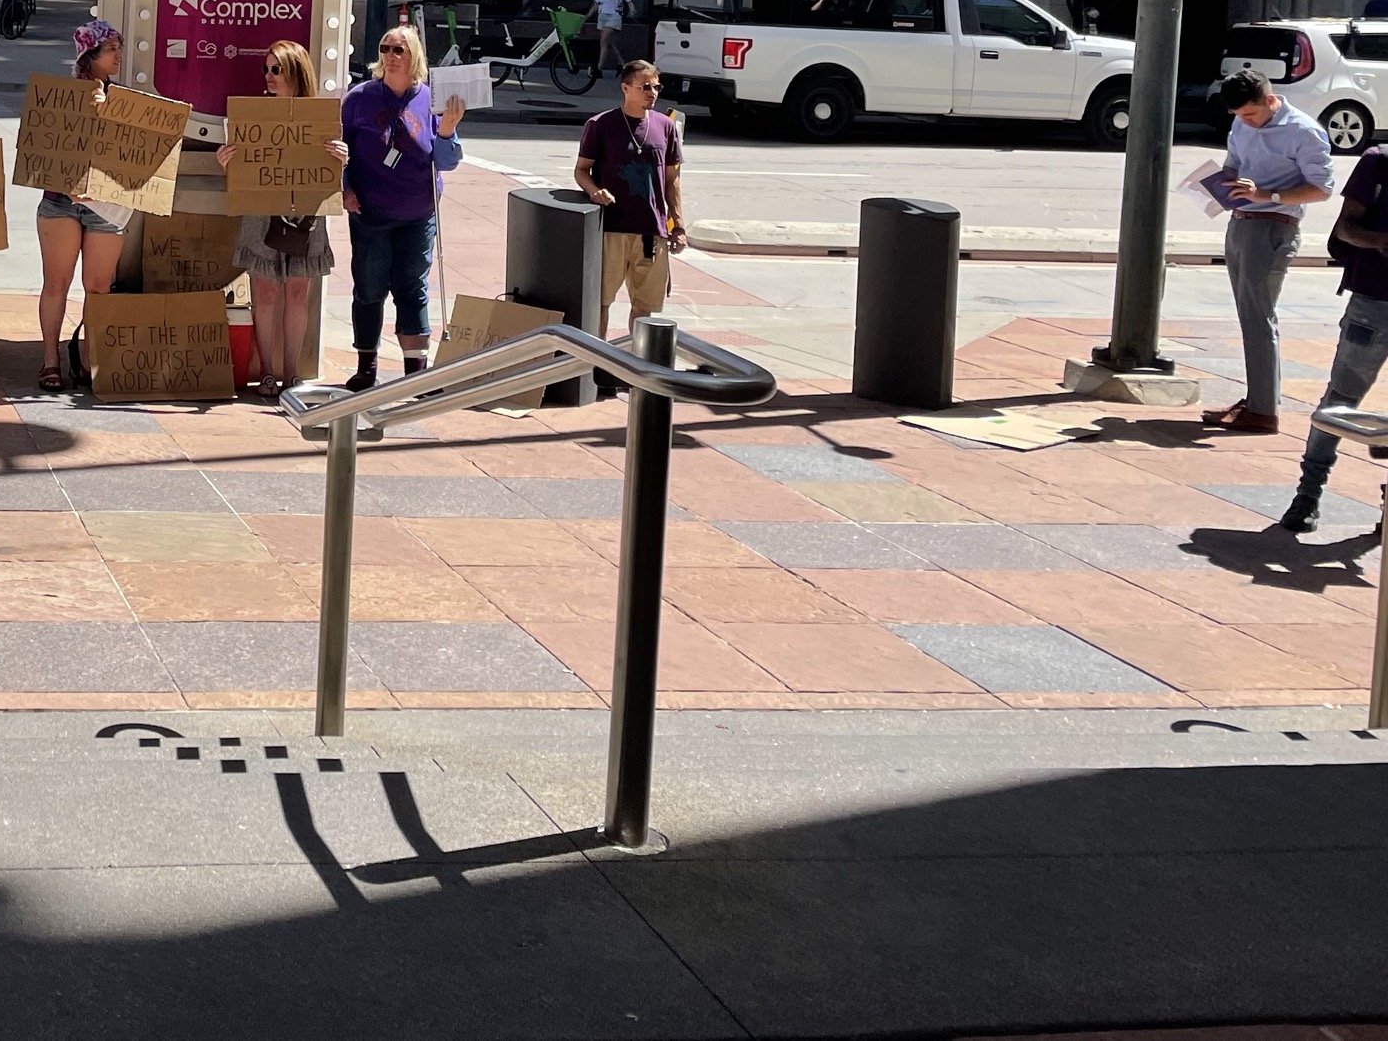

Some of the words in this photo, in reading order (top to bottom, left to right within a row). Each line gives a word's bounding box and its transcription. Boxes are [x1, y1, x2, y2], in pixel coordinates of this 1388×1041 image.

[201, 18, 251, 26] DENVER
[34, 85, 86, 112] WHAT
[27, 110, 56, 128] DO
[63, 115, 107, 138] WITH
[114, 124, 147, 149] THIS
[155, 136, 173, 157] IS
[234, 124, 262, 144] NO
[271, 124, 312, 146] ONE
[23, 132, 34, 147] A
[43, 132, 89, 152] SIGN
[94, 140, 113, 156] OF
[118, 147, 155, 166] WHAT
[243, 147, 285, 164] LEFT
[23, 152, 54, 172] YOU
[103, 169, 124, 185] DO
[128, 176, 160, 195] WITH
[259, 166, 335, 187] BEHIND
[25, 172, 53, 187] THE
[110, 189, 127, 200] OF
[132, 193, 145, 206] IT
[151, 237, 181, 258] WE
[170, 260, 219, 277] NEED
[104, 325, 137, 347] SET
[148, 326, 178, 346] THE
[188, 324, 225, 345] RIGHT
[121, 349, 197, 372] COURSE
[203, 347, 230, 366] WITH
[112, 368, 204, 392] RODEWAY
